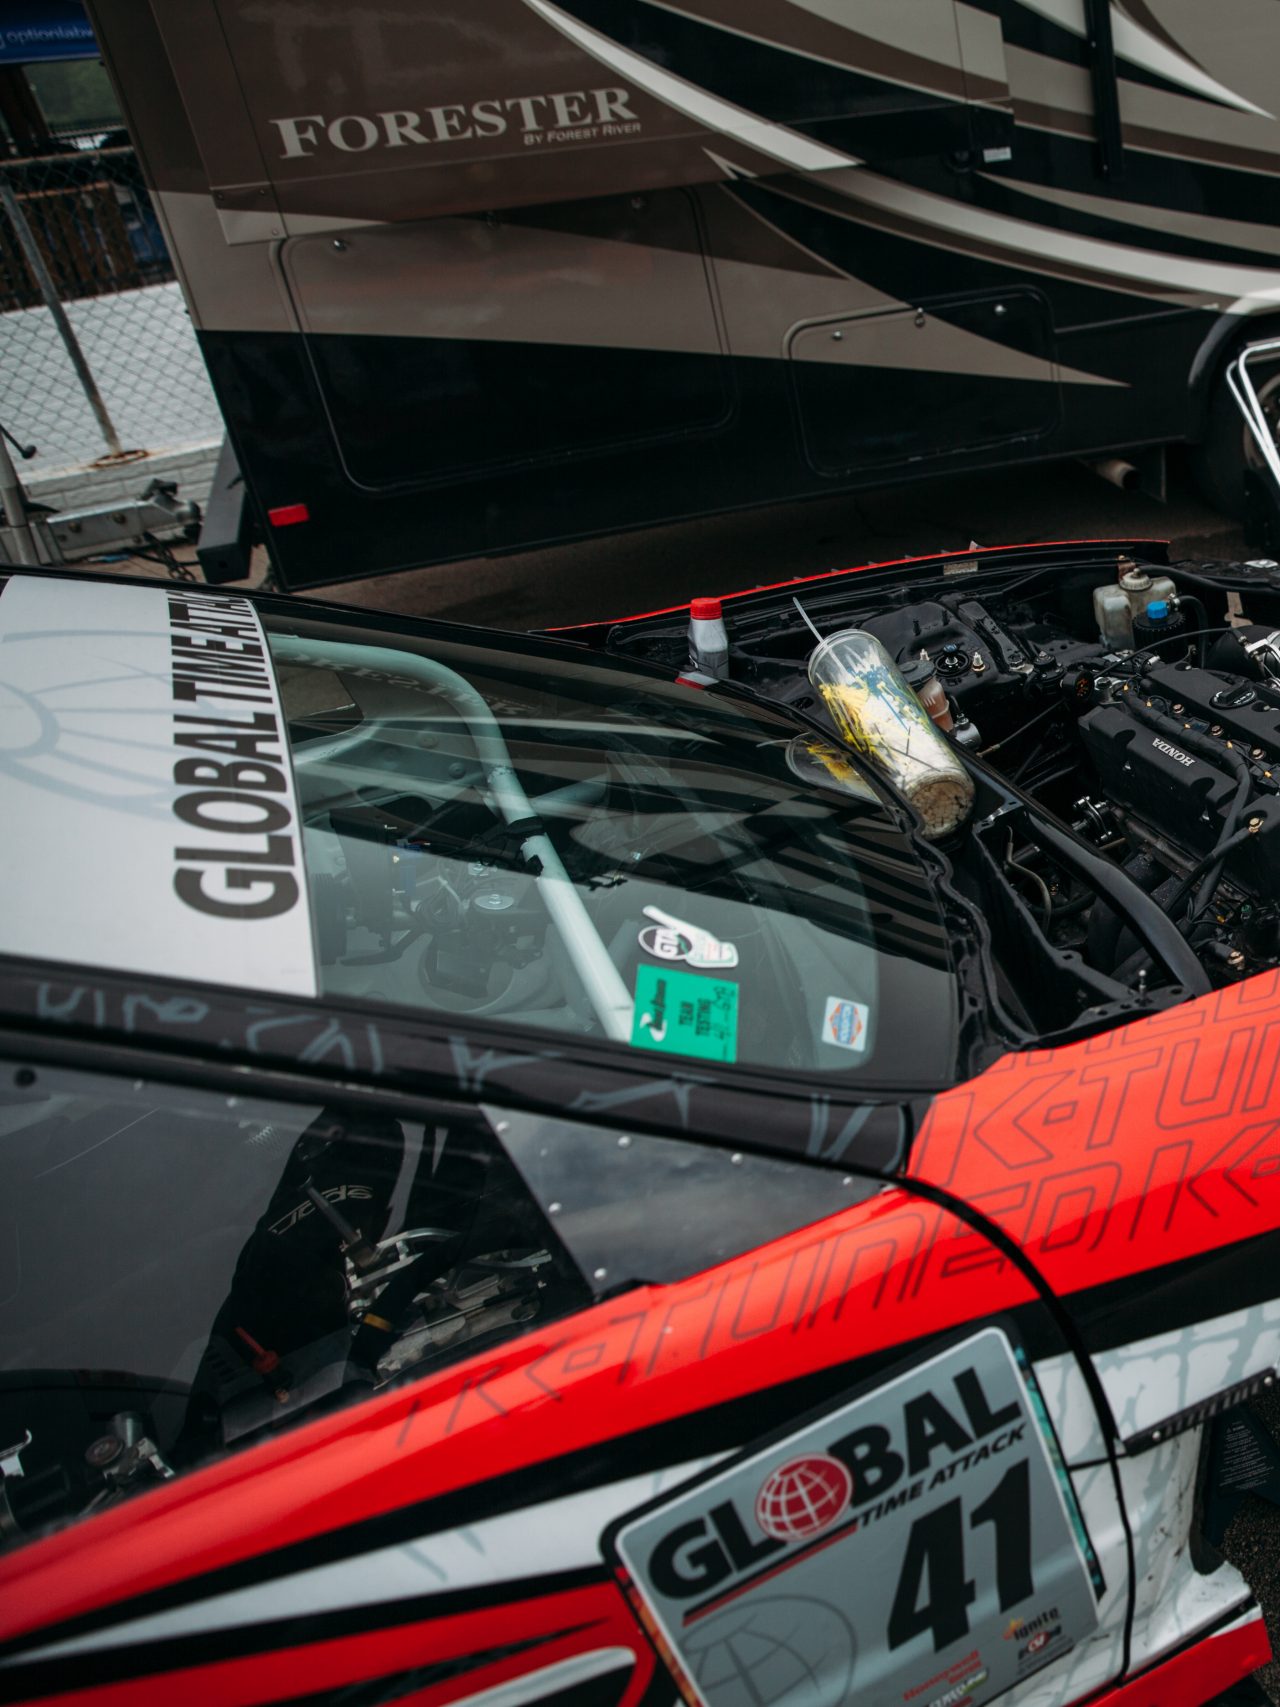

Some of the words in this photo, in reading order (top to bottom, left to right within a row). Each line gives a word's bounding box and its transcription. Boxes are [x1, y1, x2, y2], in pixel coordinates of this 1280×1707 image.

[268, 86, 639, 159] FORESTER
[524, 132, 543, 146] BY
[547, 127, 598, 143] FOREST
[602, 122, 641, 136] RIVER
[165, 590, 261, 642] ATTA
[172, 634, 274, 704] TIME
[1152, 738, 1195, 766] HONDA
[172, 711, 300, 920] GLOBAL
[861, 1478, 925, 1528] TIME
[928, 1421, 1027, 1491] ATTACK
[887, 1457, 1035, 1654] 41
